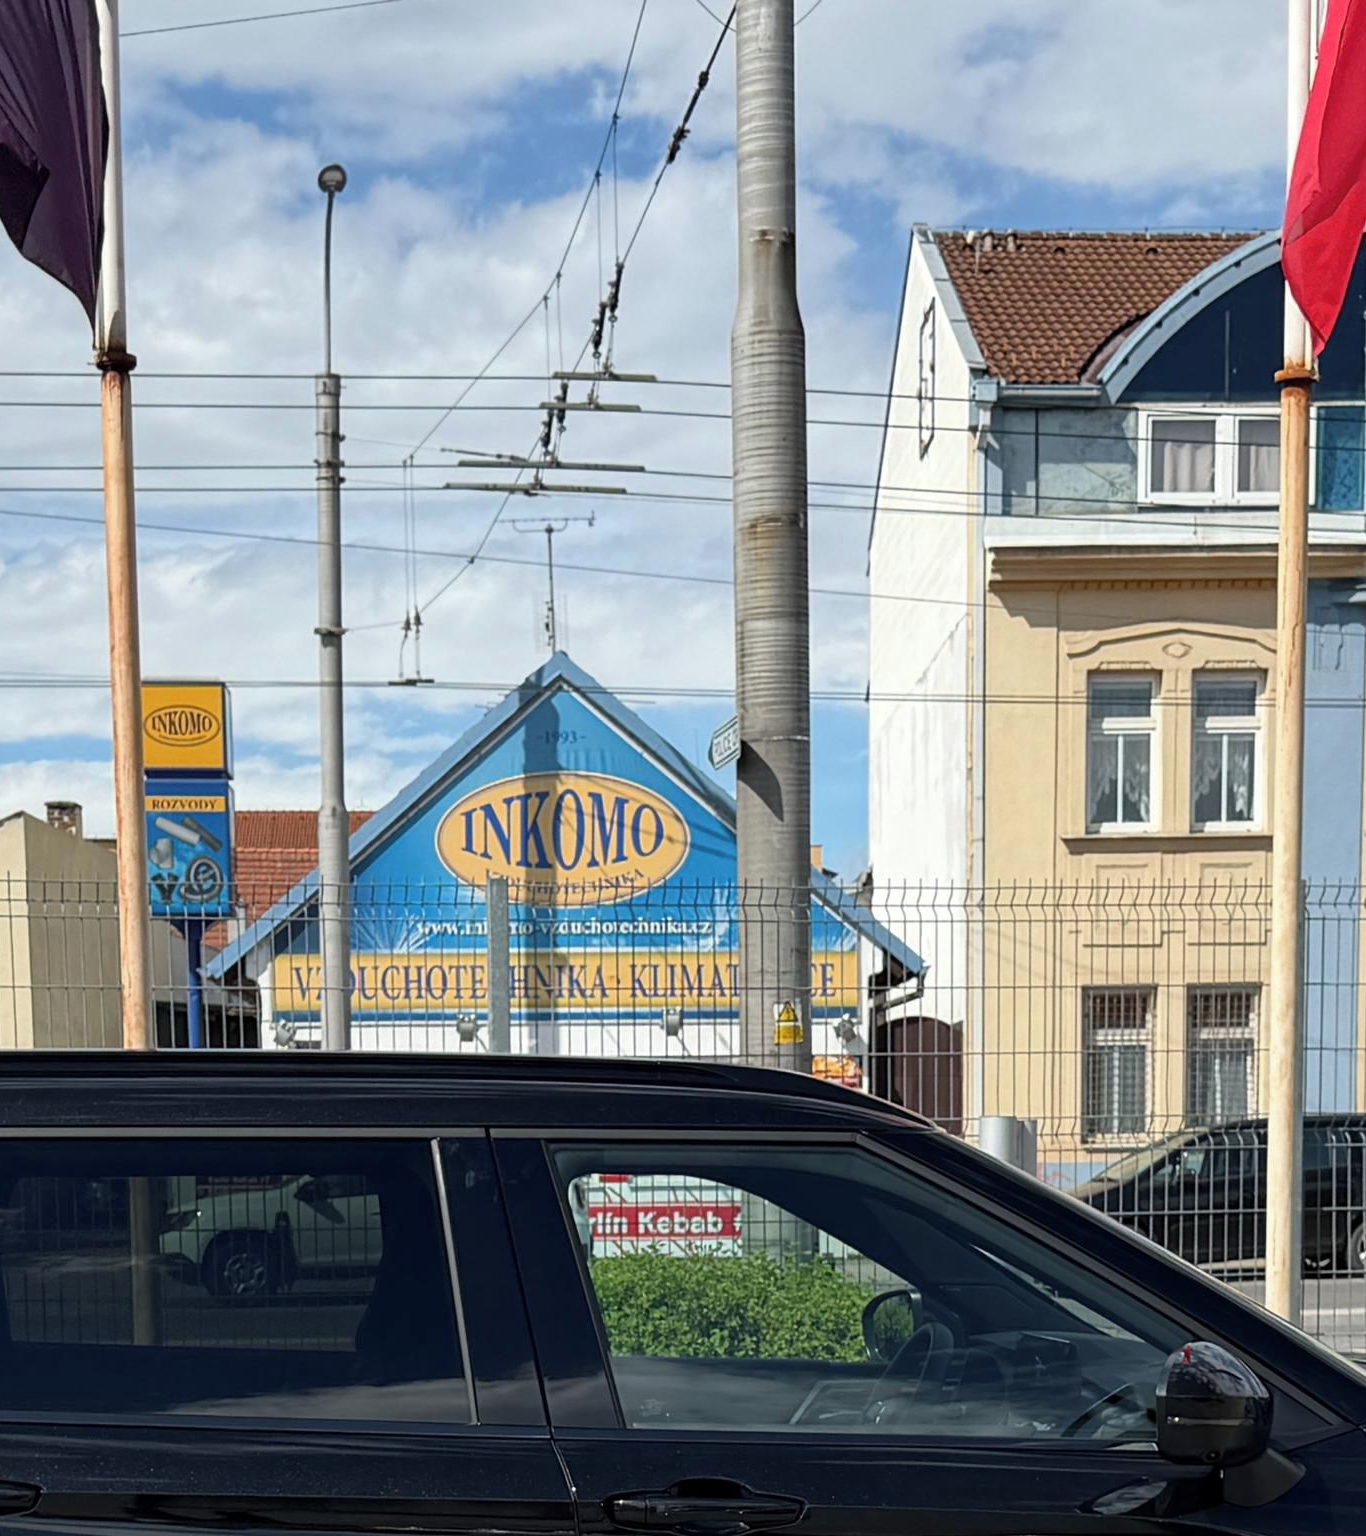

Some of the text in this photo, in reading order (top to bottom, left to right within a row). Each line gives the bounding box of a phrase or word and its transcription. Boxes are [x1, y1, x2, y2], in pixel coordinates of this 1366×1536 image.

[151, 710, 213, 736] INKOMO
[152, 799, 218, 811] ROZVODY
[461, 788, 664, 871] INKOMO
[638, 1211, 723, 1234] Kebab
